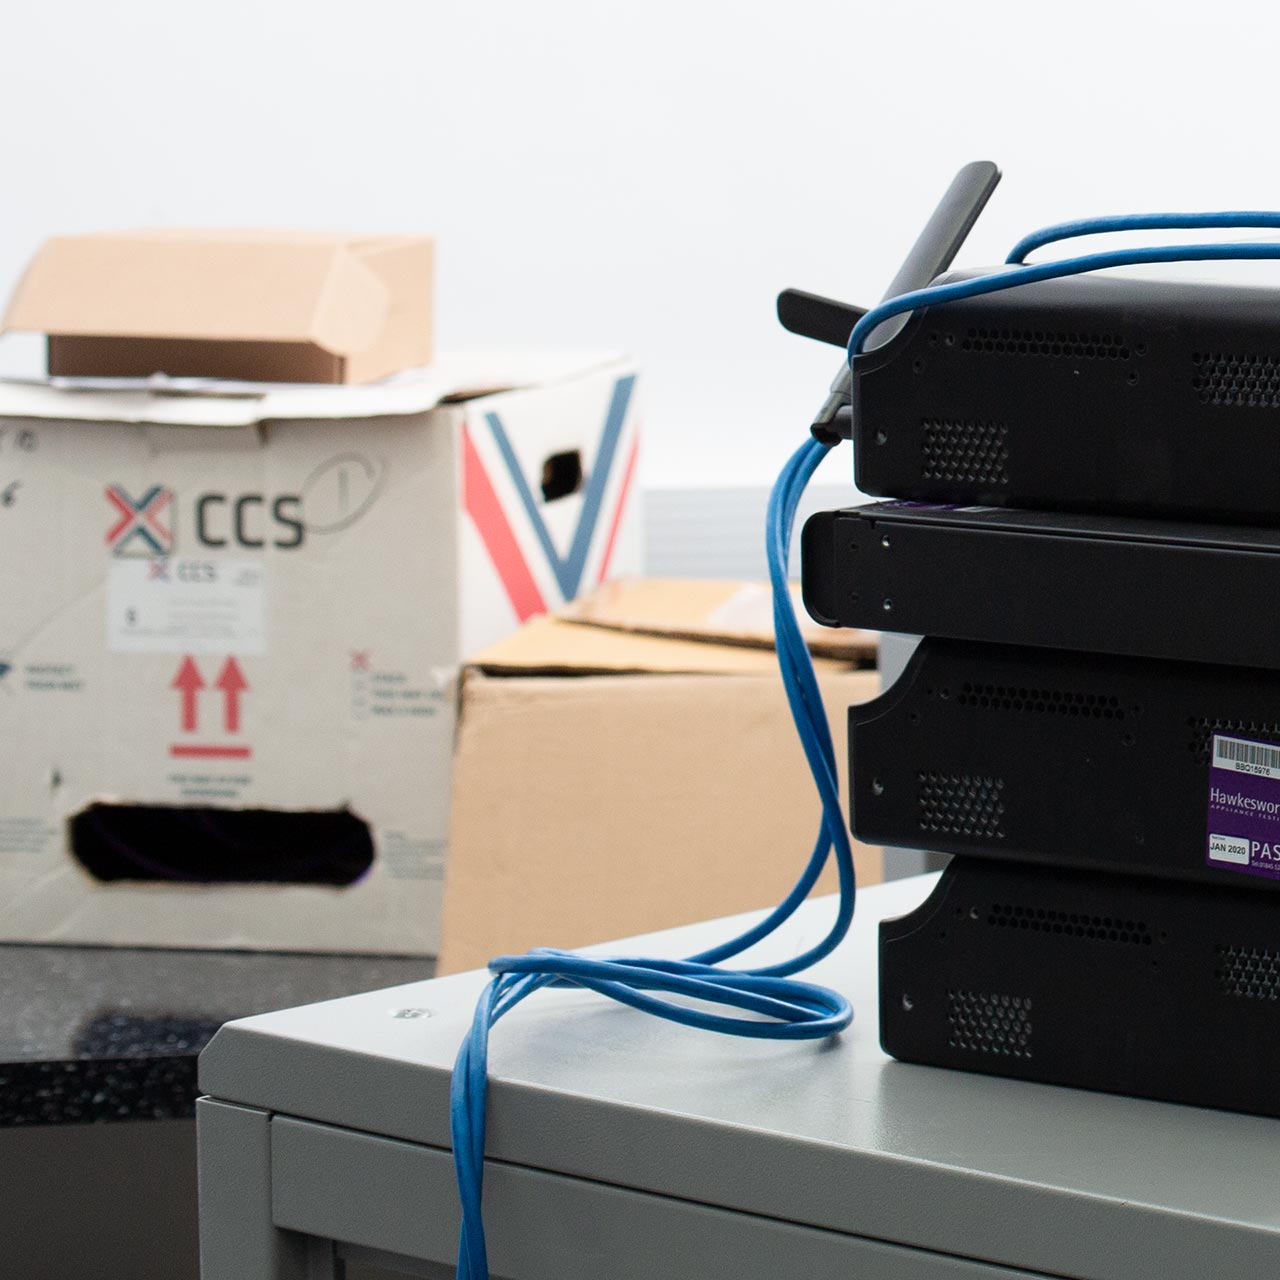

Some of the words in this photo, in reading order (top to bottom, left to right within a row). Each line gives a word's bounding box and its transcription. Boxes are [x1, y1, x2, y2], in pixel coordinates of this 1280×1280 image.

[195, 490, 307, 552] CCS
[1210, 803, 1254, 817] APPLIANCE
[1209, 841, 1227, 853] JAN
[1227, 843, 1247, 855] 2020
